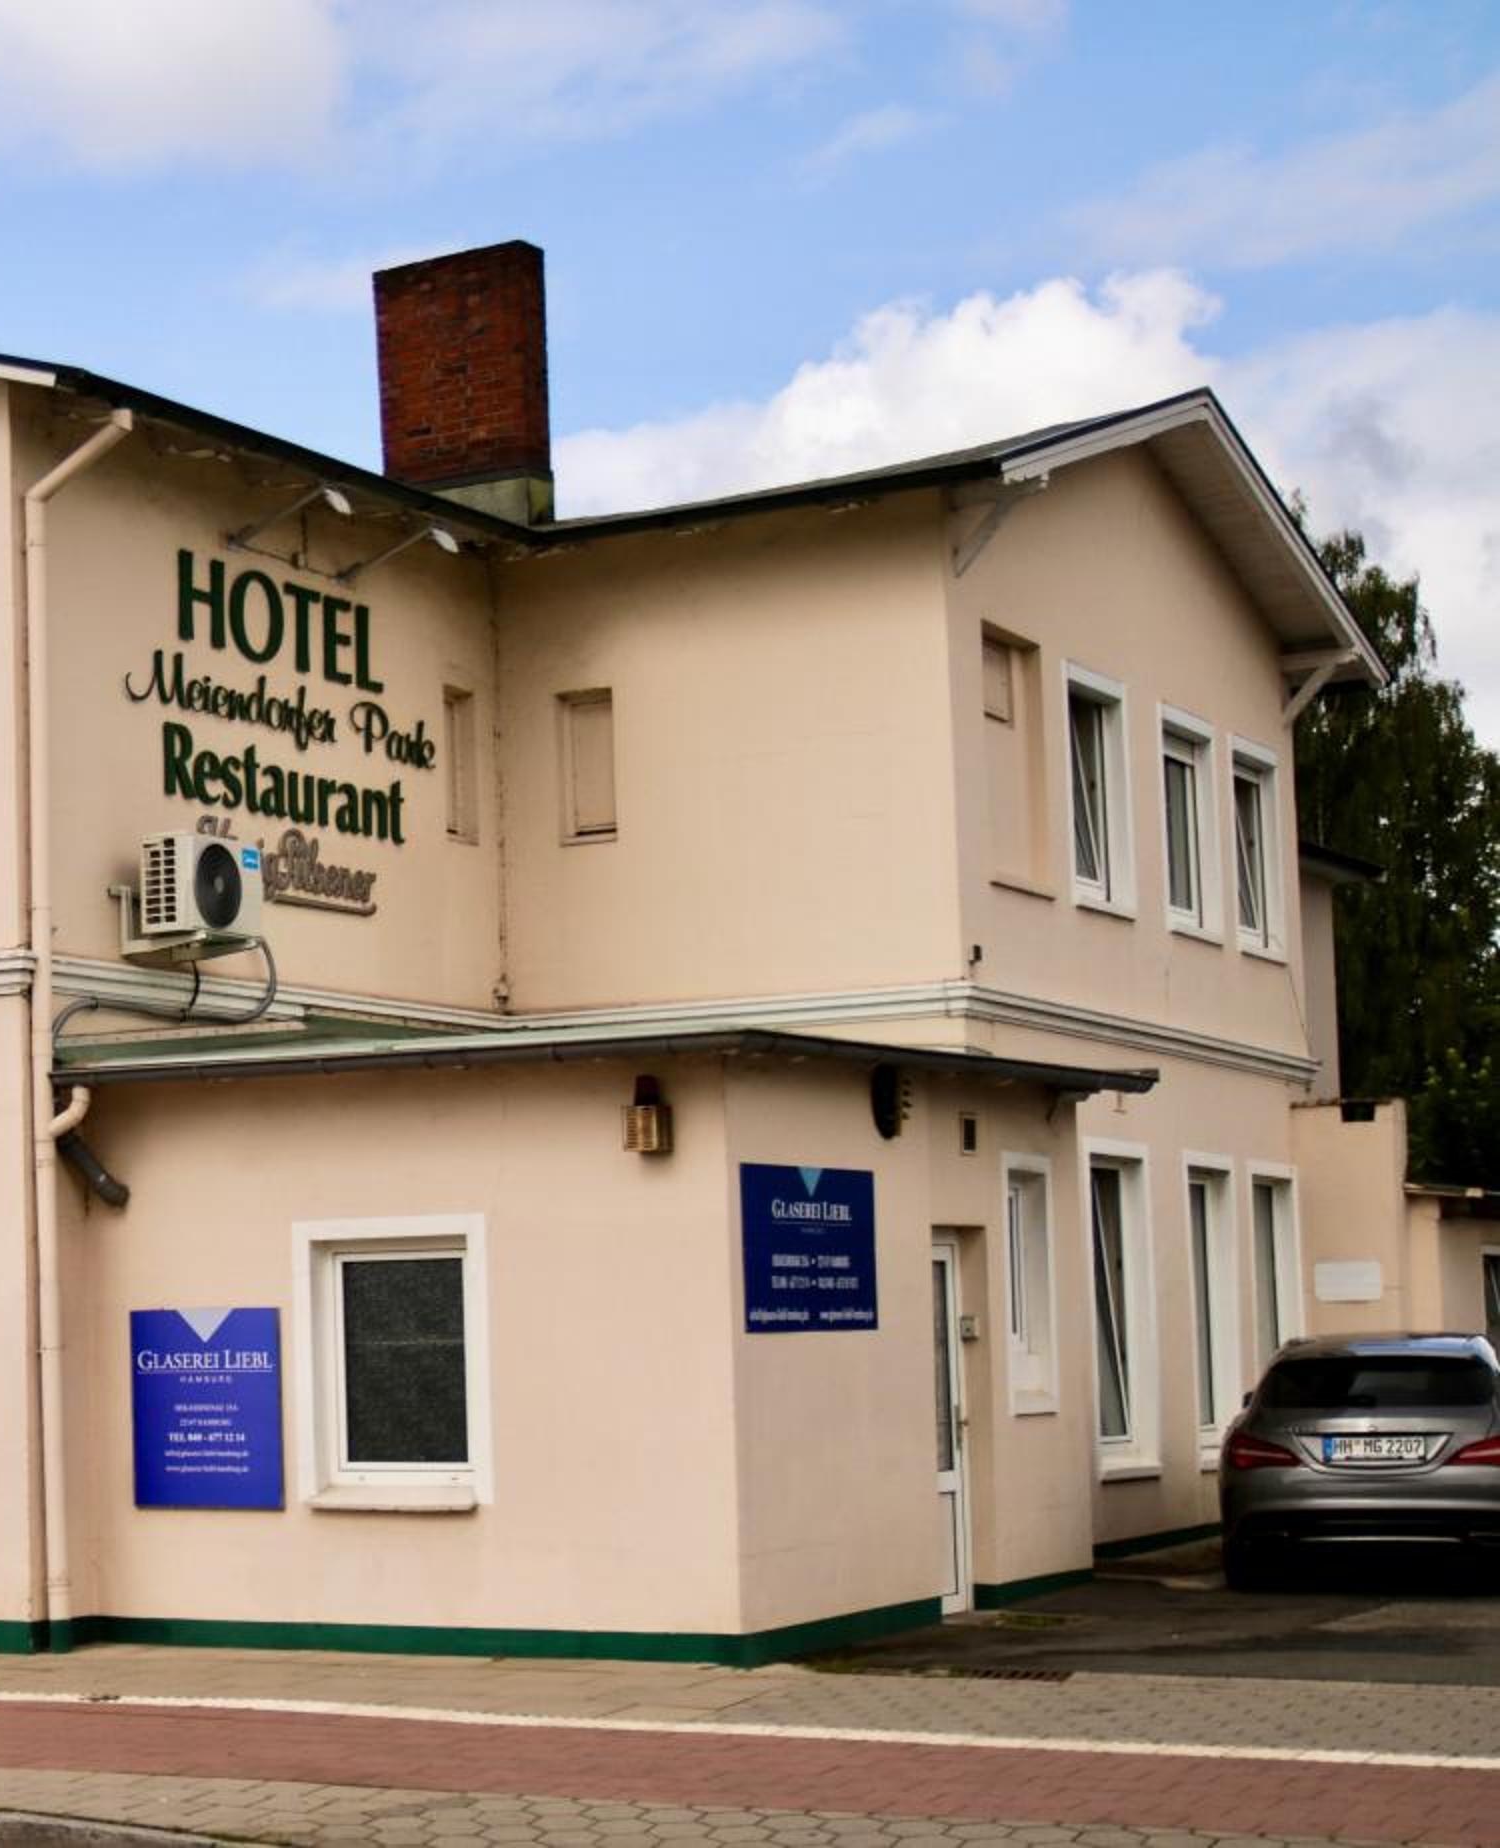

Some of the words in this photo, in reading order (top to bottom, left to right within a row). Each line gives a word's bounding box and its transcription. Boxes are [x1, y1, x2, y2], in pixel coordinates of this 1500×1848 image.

[177, 549, 384, 694] HOTEL
[125, 649, 337, 752] Meiendorfer
[349, 701, 436, 771] Park
[162, 721, 406, 845] Restaurant
[137, 1349, 219, 1370] GLASEREI
[224, 1349, 273, 1369] LIEBL
[1364, 1439, 1382, 1454] MG
